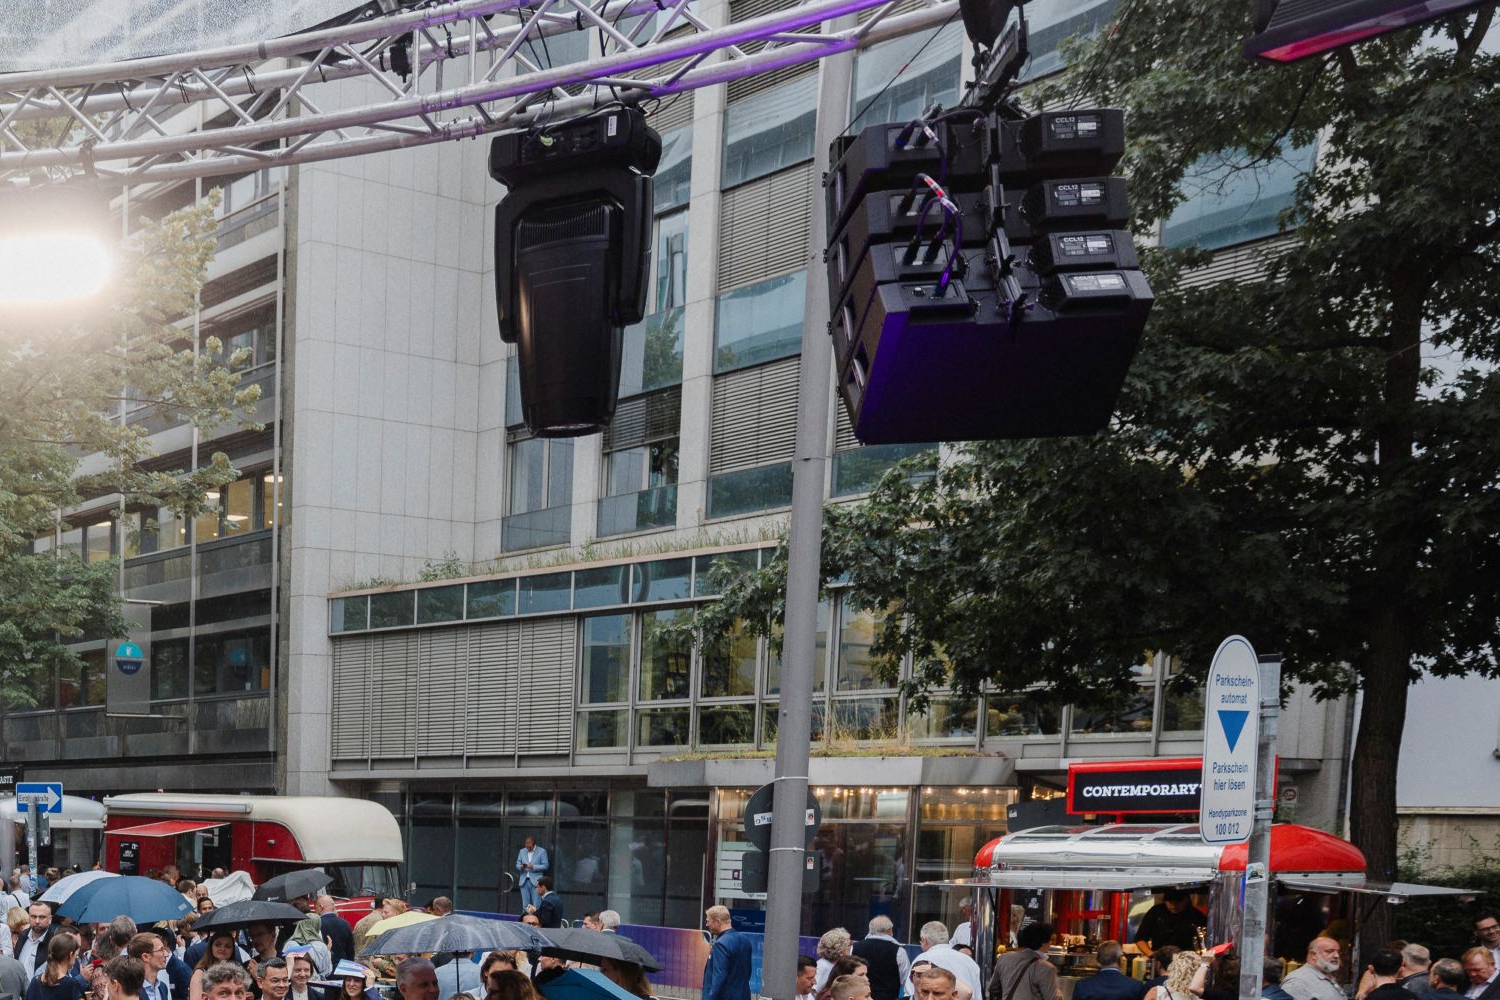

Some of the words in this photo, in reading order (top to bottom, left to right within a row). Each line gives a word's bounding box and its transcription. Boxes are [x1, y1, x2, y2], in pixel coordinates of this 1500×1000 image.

[1216, 674, 1254, 687] Parkschein-
[1220, 693, 1248, 704] automat
[1212, 762, 1249, 774] Parkschein
[1082, 783, 1199, 798] CONTEMPORARY
[1213, 779, 1227, 791] hier
[1228, 778, 1246, 790] lösen
[1208, 808, 1248, 819] Handyparkzone
[1215, 823, 1227, 835] 100
[1227, 823, 1240, 834] 012
